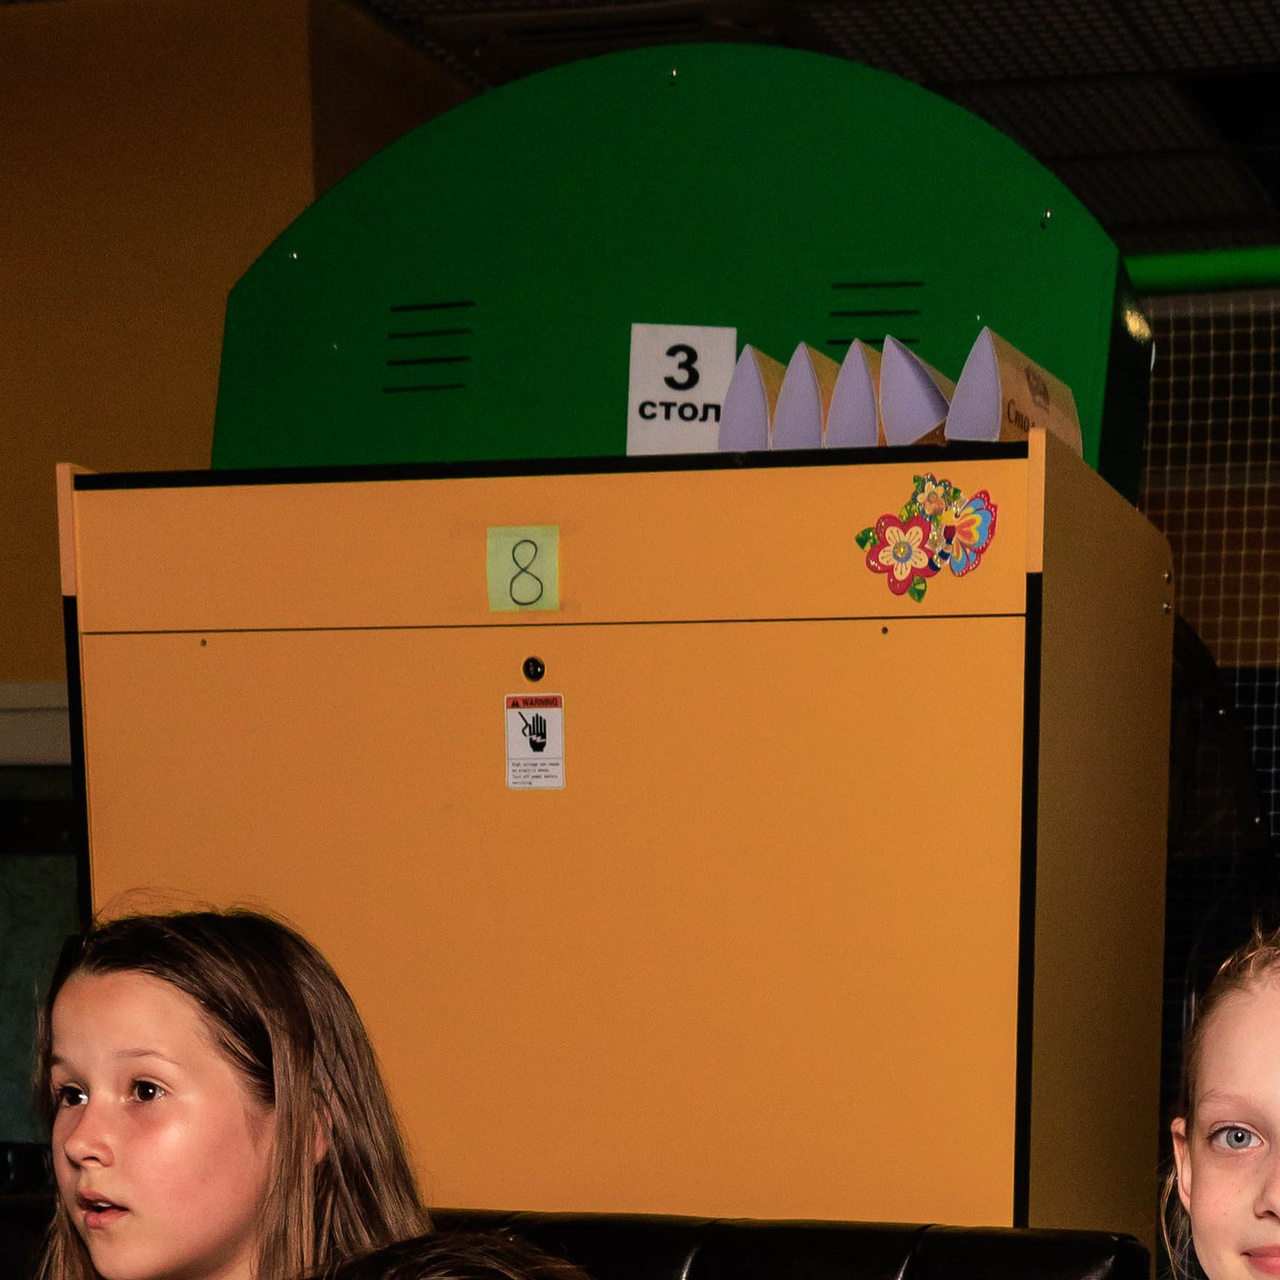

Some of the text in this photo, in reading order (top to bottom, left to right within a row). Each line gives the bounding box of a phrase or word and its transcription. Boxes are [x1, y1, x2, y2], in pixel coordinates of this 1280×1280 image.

[664, 343, 700, 391] 3
[509, 539, 543, 606] 8
[522, 698, 557, 707] WARNING
